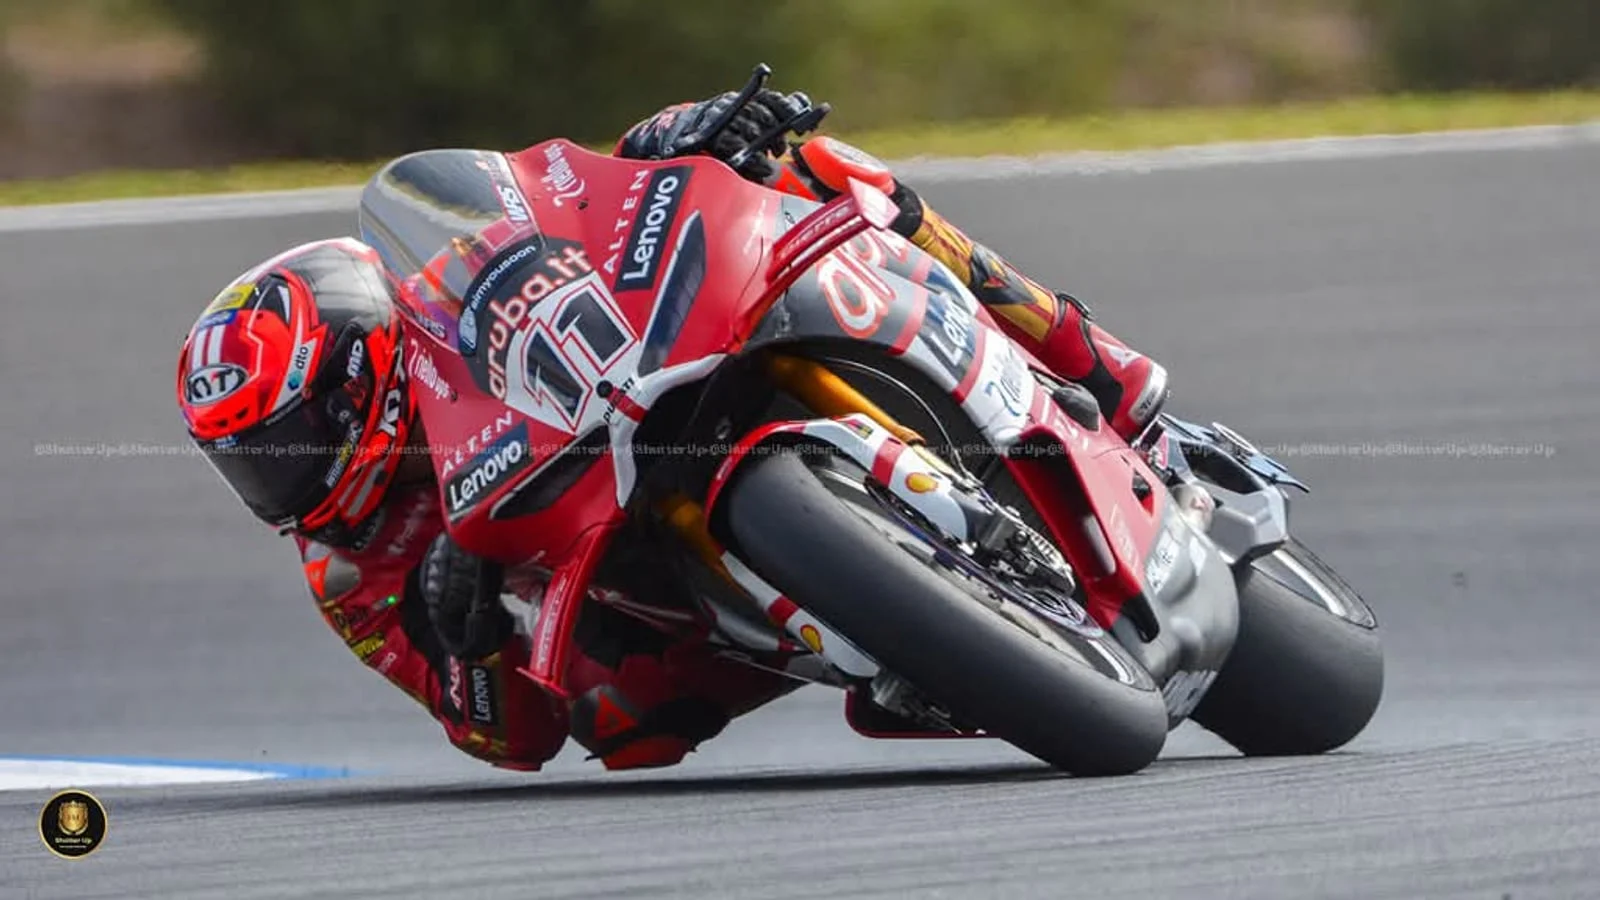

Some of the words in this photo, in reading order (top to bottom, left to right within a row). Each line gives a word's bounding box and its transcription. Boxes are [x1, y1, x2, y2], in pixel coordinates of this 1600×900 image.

[603, 169, 649, 274] ALTEN
[622, 175, 679, 281] Lenovo
[488, 247, 592, 400] aruba.it
[521, 281, 638, 431] 11
[441, 410, 513, 478] ALTEN
[450, 439, 523, 512] Lenovo
[473, 667, 492, 722] Lenovo
